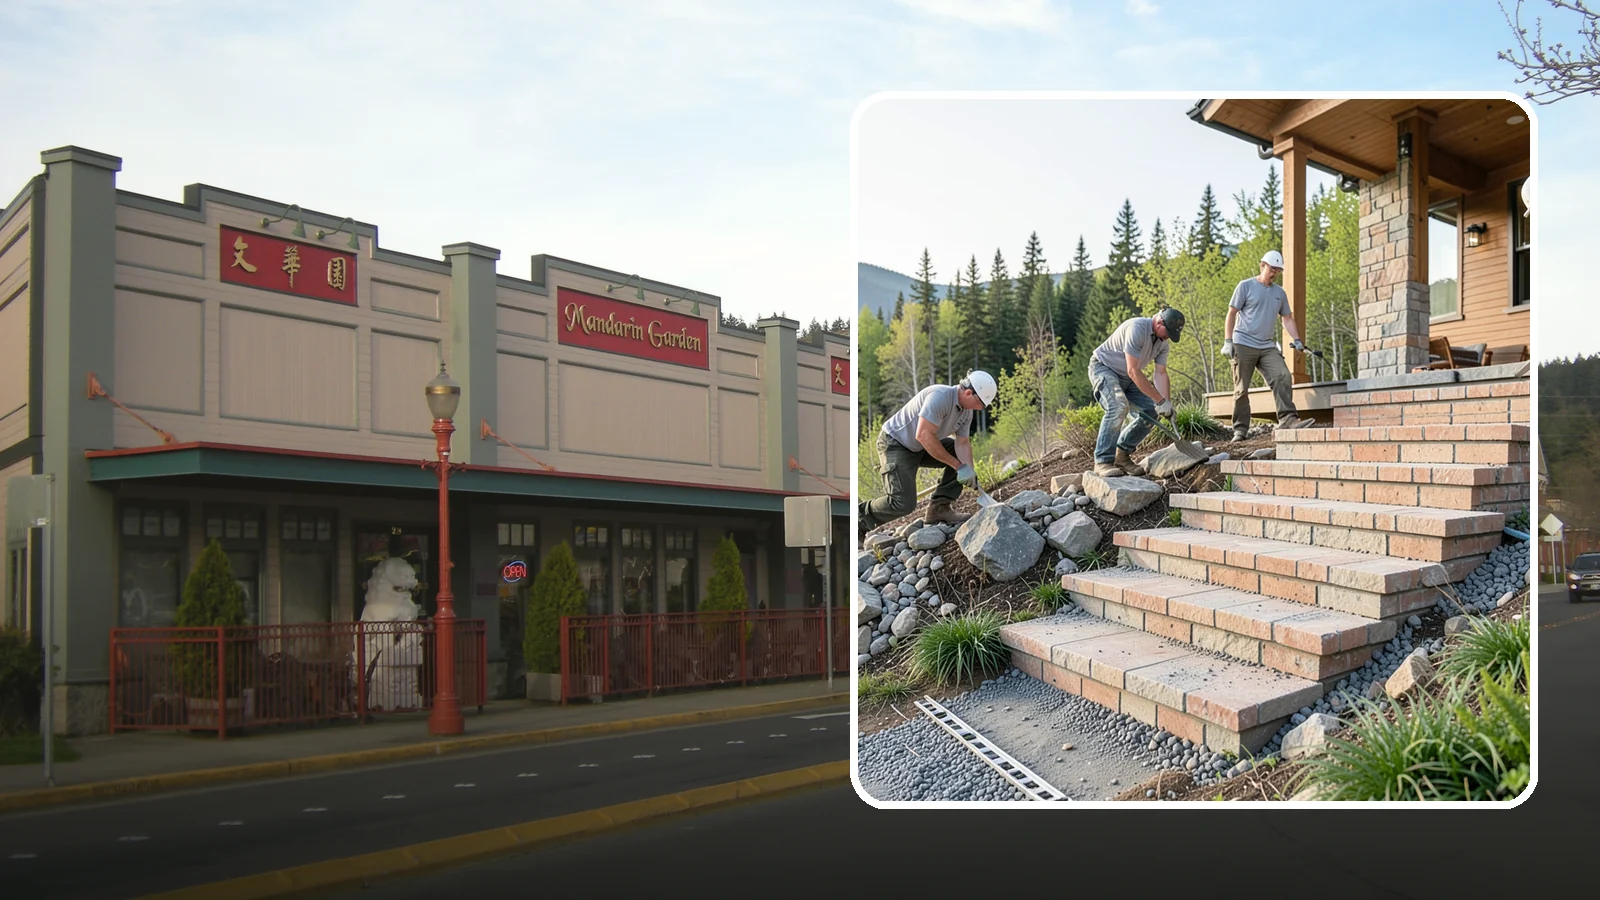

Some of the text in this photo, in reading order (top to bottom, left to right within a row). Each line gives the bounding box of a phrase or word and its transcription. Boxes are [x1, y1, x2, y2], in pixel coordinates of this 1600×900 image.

[230, 235, 347, 291] 文華園
[564, 302, 701, 352] Mandarin Garden
[503, 565, 527, 578] OPEN
